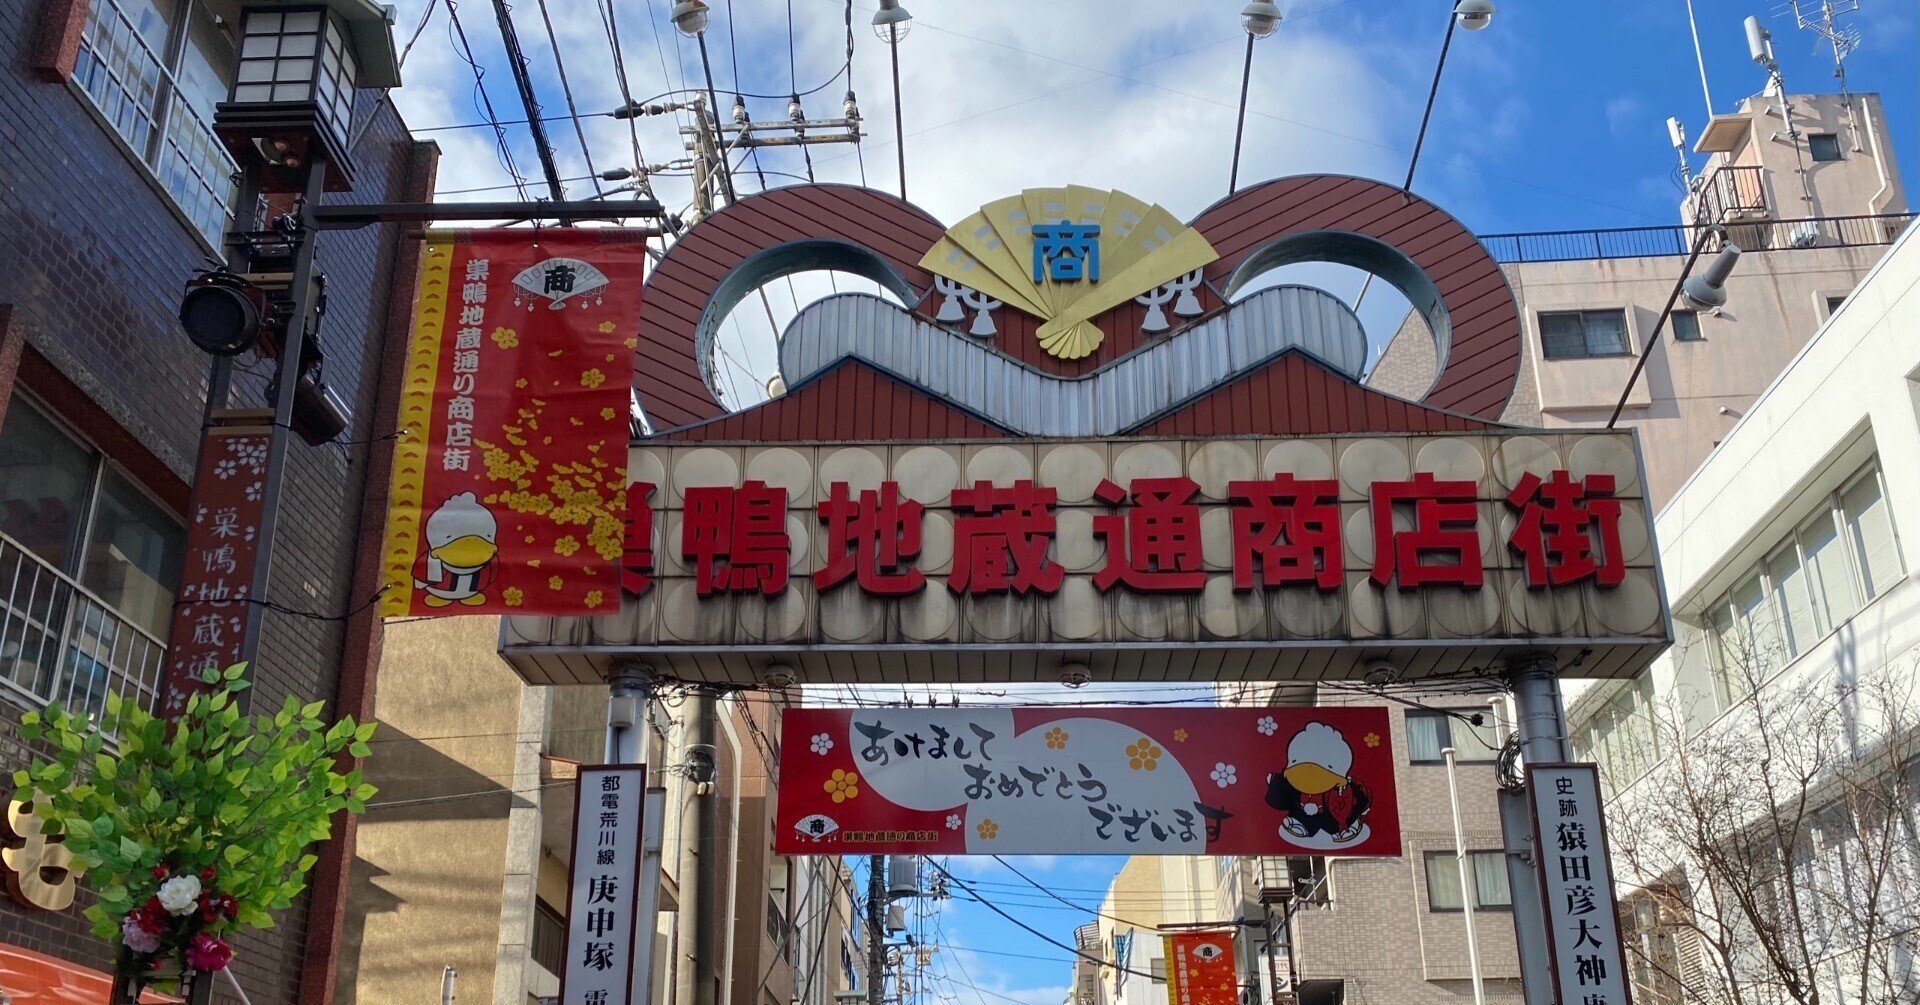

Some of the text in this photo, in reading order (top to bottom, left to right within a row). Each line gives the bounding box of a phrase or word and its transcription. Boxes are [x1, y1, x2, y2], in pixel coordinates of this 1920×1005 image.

[1031, 219, 1101, 284] 商
[543, 264, 576, 295] 商
[443, 258, 490, 472] 巣鴨地蔵通り商店街
[853, 719, 997, 767] あけまして
[962, 762, 1107, 803] おめでとう
[596, 774, 622, 866] 都電荒川線
[809, 818, 826, 835] 商
[842, 830, 939, 843] 巣鴨地蔵通り商店街
[1088, 801, 1235, 843] ございます
[582, 874, 619, 973] 庚申塚
